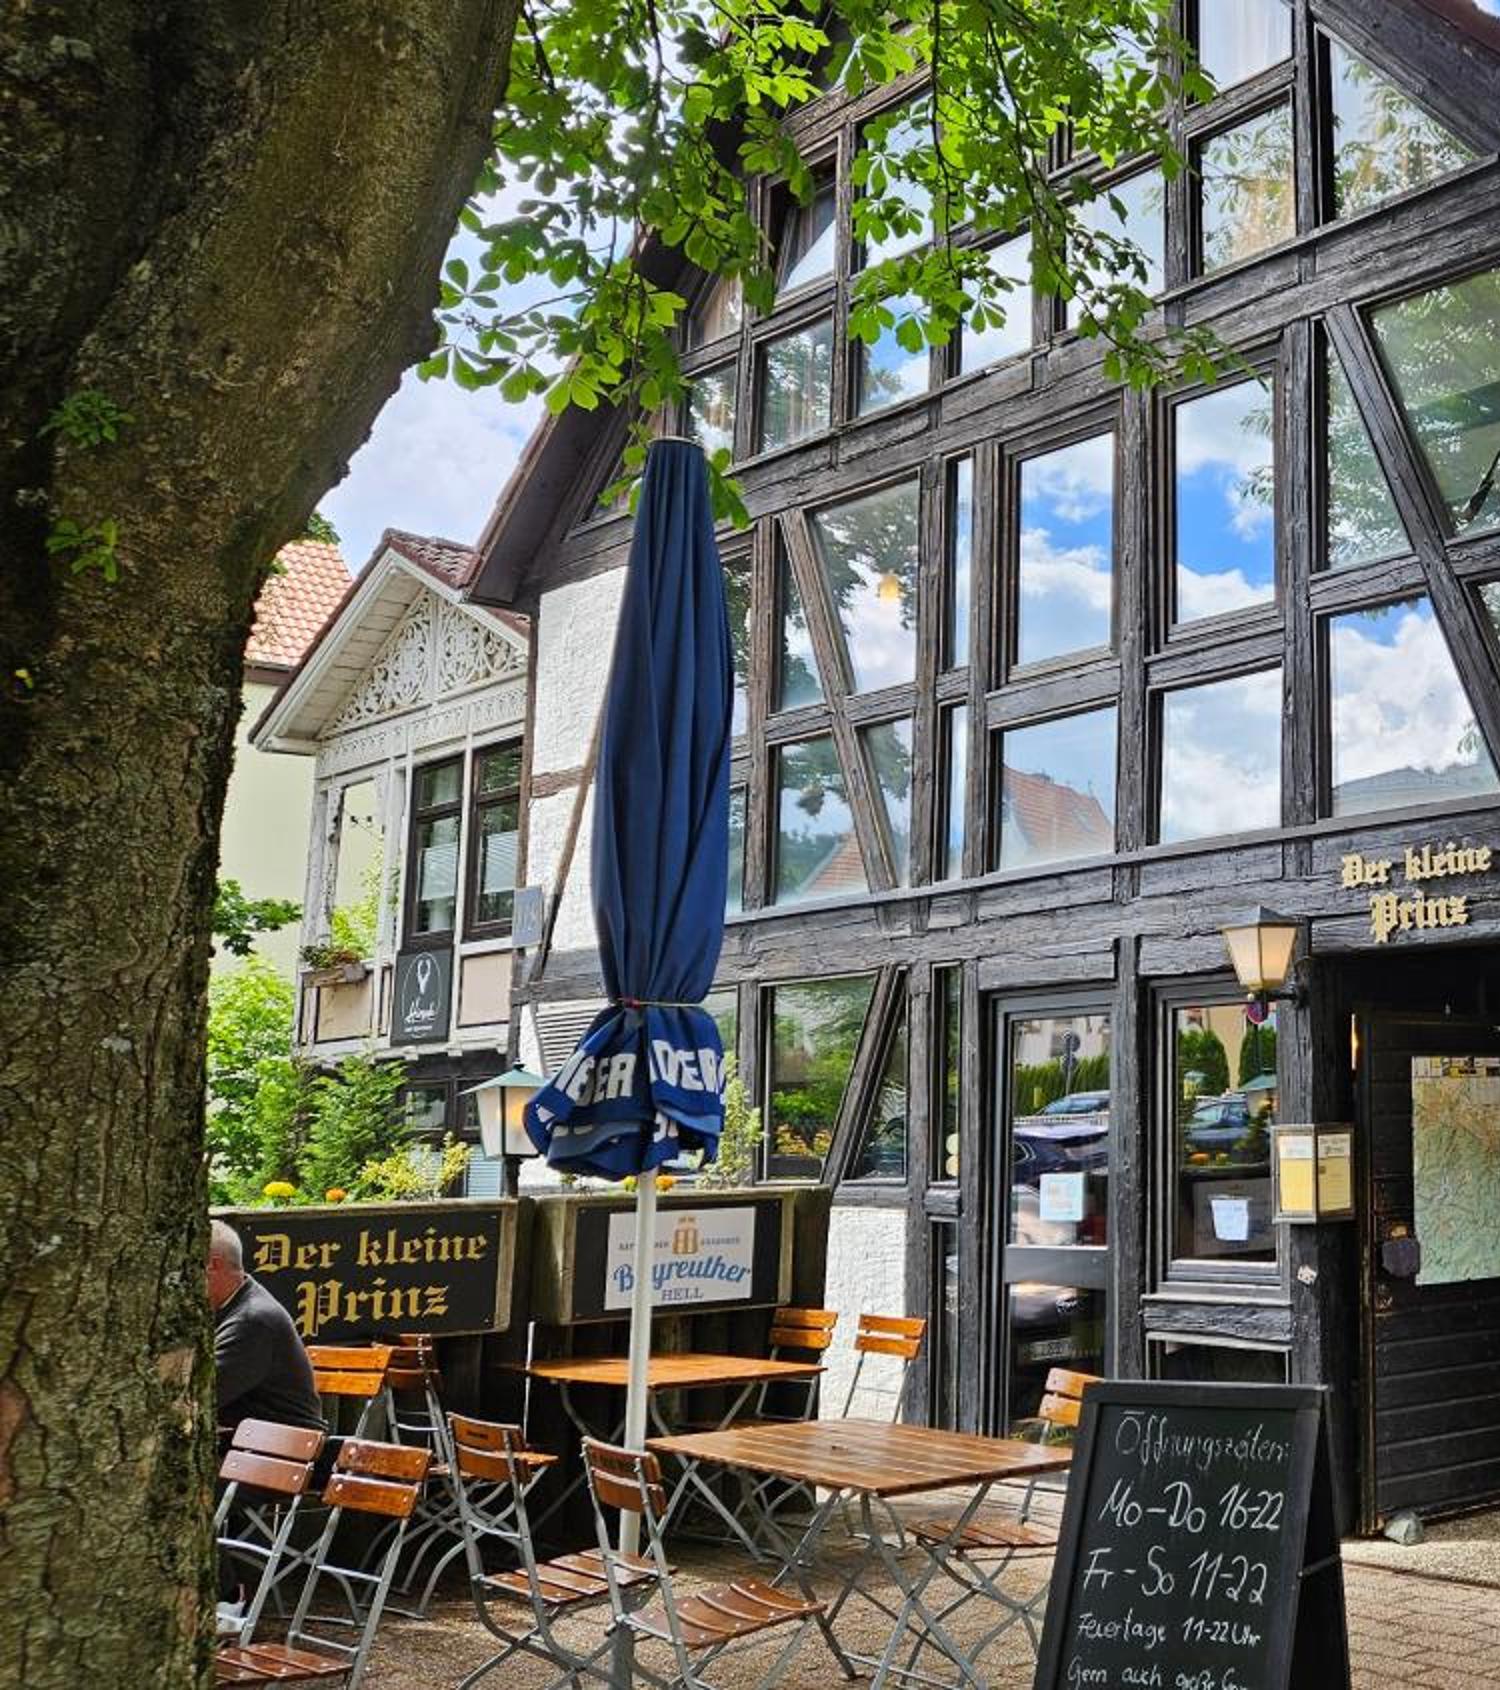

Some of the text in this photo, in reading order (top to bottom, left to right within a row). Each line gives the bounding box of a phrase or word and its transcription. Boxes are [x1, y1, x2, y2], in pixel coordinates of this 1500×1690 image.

[1341, 841, 1491, 888] Der kleine
[1369, 889, 1468, 943] Prinz
[253, 1227, 487, 1272] Der kleine
[613, 1254, 751, 1293] Byreuther
[661, 1287, 704, 1302] HELL
[296, 1277, 449, 1337] Prinz
[1219, 1481, 1284, 1530] 16-22
[1189, 1551, 1267, 1605] 11-22
[1078, 1607, 1167, 1650] Feiertage
[1230, 1624, 1261, 1648] Uhr
[1121, 1664, 1162, 1688] auch
